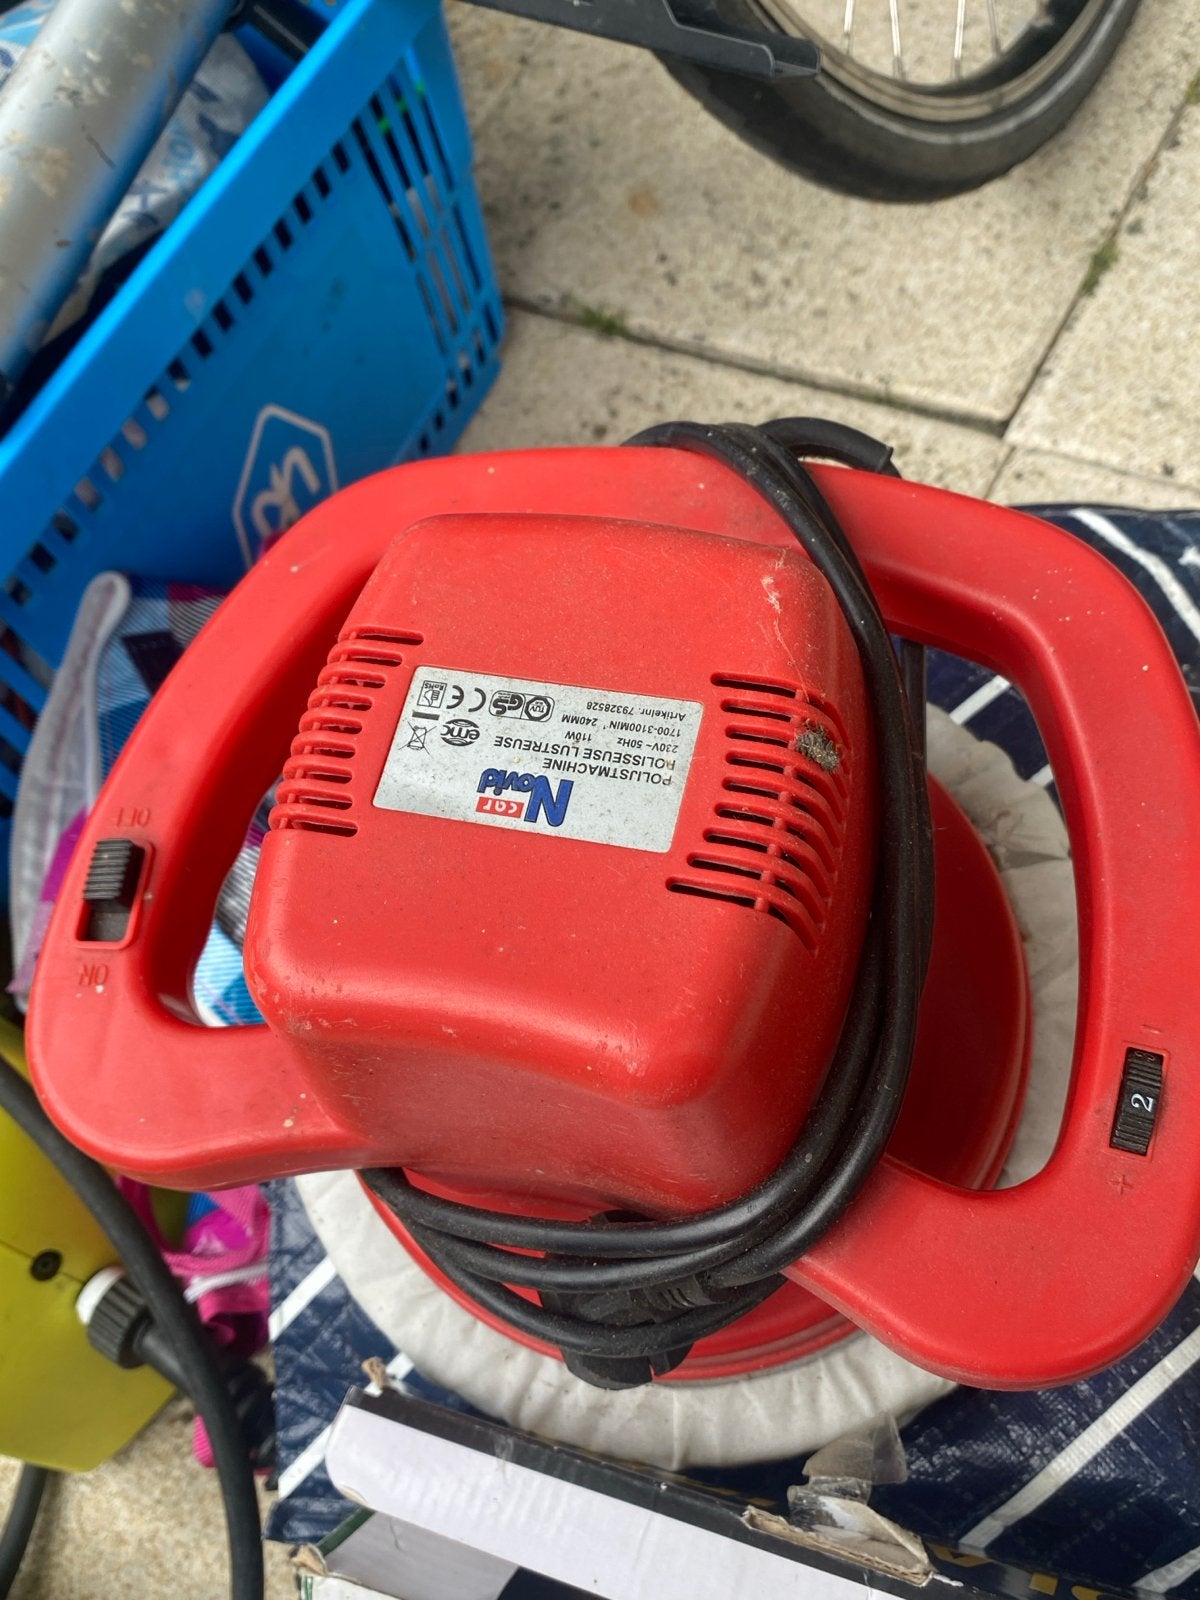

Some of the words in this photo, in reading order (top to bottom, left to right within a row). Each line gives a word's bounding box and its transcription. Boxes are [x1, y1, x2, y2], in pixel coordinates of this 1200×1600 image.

[586, 701, 634, 716] 79328528
[638, 708, 687, 722] Artikelnr.
[561, 713, 598, 727] 240MM
[564, 730, 592, 742] 110W
[617, 737, 643, 749] 50Hz
[493, 735, 579, 757] LUSTREUSE
[542, 757, 673, 786] POLIJSTMACHINE
[477, 767, 575, 828] Novid
[482, 800, 518, 814] car
[1130, 1092, 1154, 1113] 2
